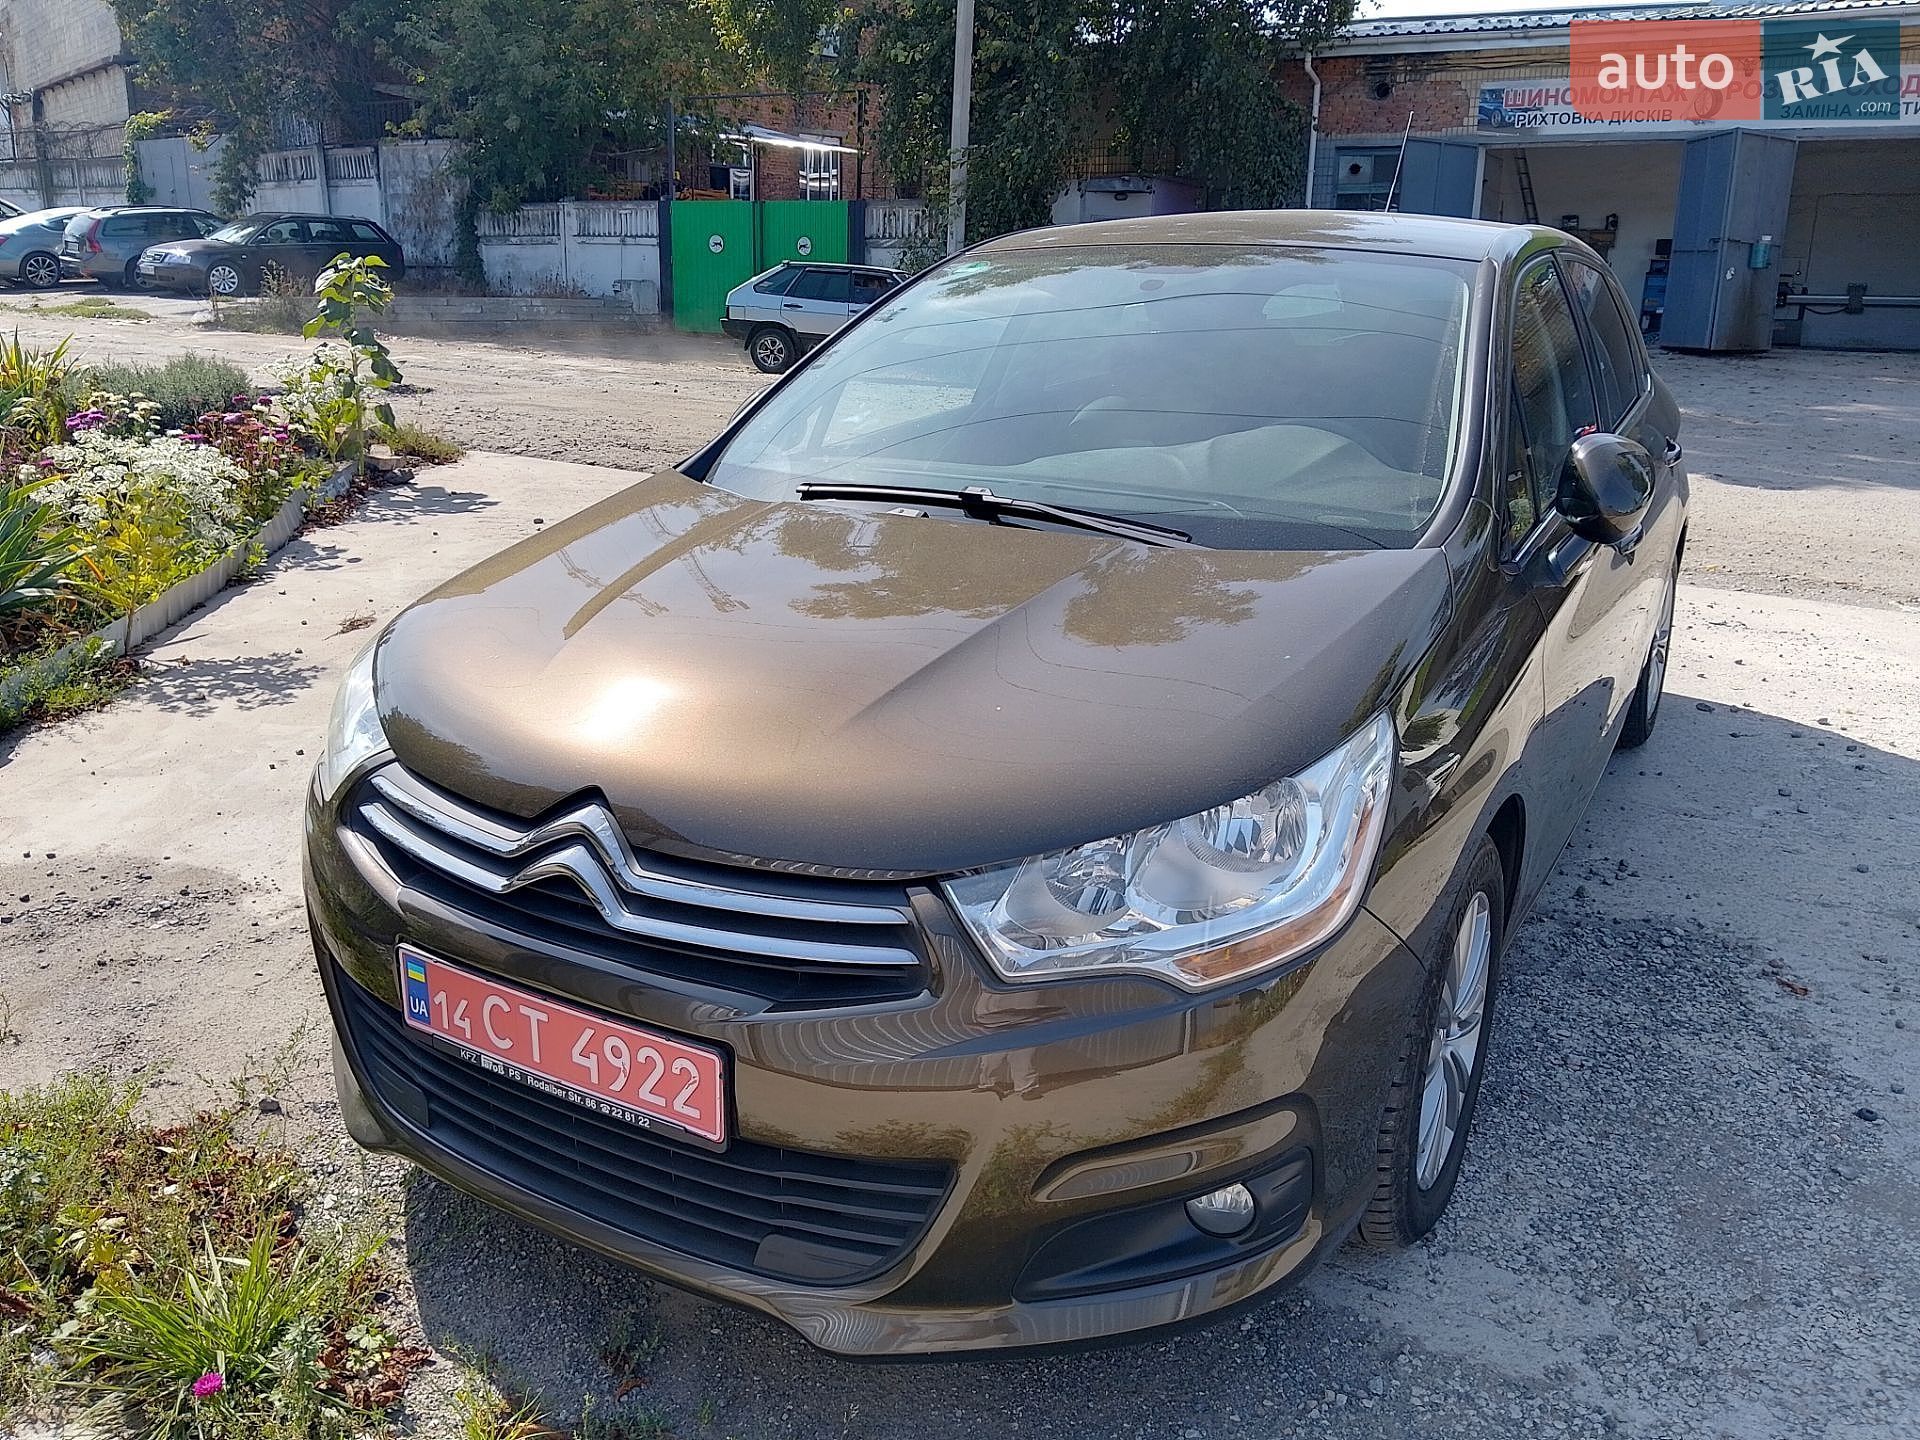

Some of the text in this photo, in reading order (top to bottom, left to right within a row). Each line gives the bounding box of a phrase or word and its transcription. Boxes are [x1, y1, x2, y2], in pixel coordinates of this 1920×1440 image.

[1504, 83, 1689, 108] ШИНОМОНТАЖ
[1516, 108, 1673, 128] РИХТОВКА ДИСКІВ
[1780, 103, 1853, 119] ЗАМІНА
[410, 995, 429, 1018] UA
[571, 1027, 701, 1120] 4922
[460, 1048, 477, 1064] KFZ
[508, 1068, 521, 1081] PS
[527, 1075, 566, 1098] Rodalber
[568, 1091, 584, 1105] Str.
[585, 1097, 597, 1110] 86
[611, 1106, 623, 1119] 22
[638, 1116, 651, 1129] 22
